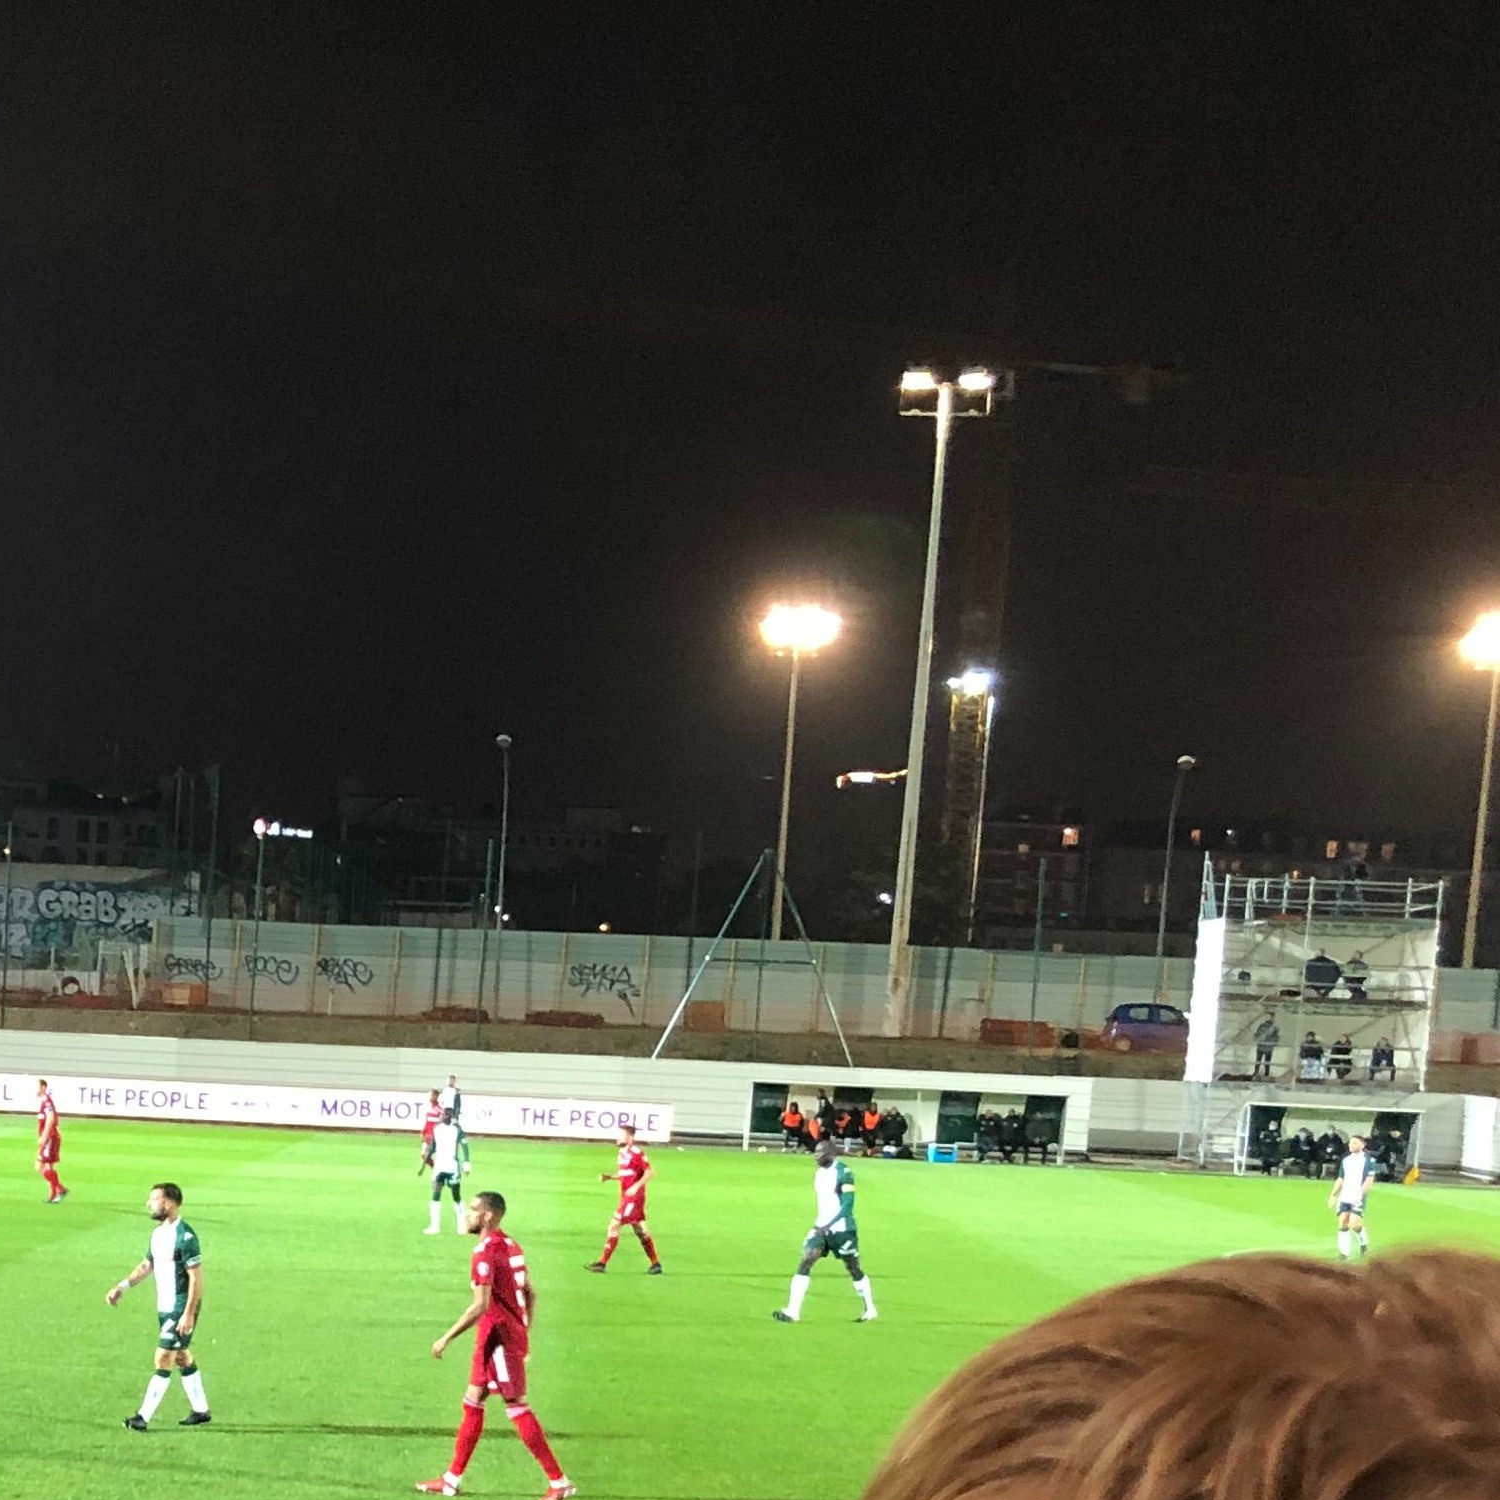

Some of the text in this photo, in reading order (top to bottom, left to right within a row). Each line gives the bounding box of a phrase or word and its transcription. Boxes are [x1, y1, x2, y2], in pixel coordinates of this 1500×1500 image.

[79, 1086, 115, 1105] THE
[124, 1089, 210, 1109] PEOPLE
[321, 1099, 423, 1119] MOB HOT
[521, 1108, 560, 1127] THE
[570, 1110, 660, 1131] PEOPLE
